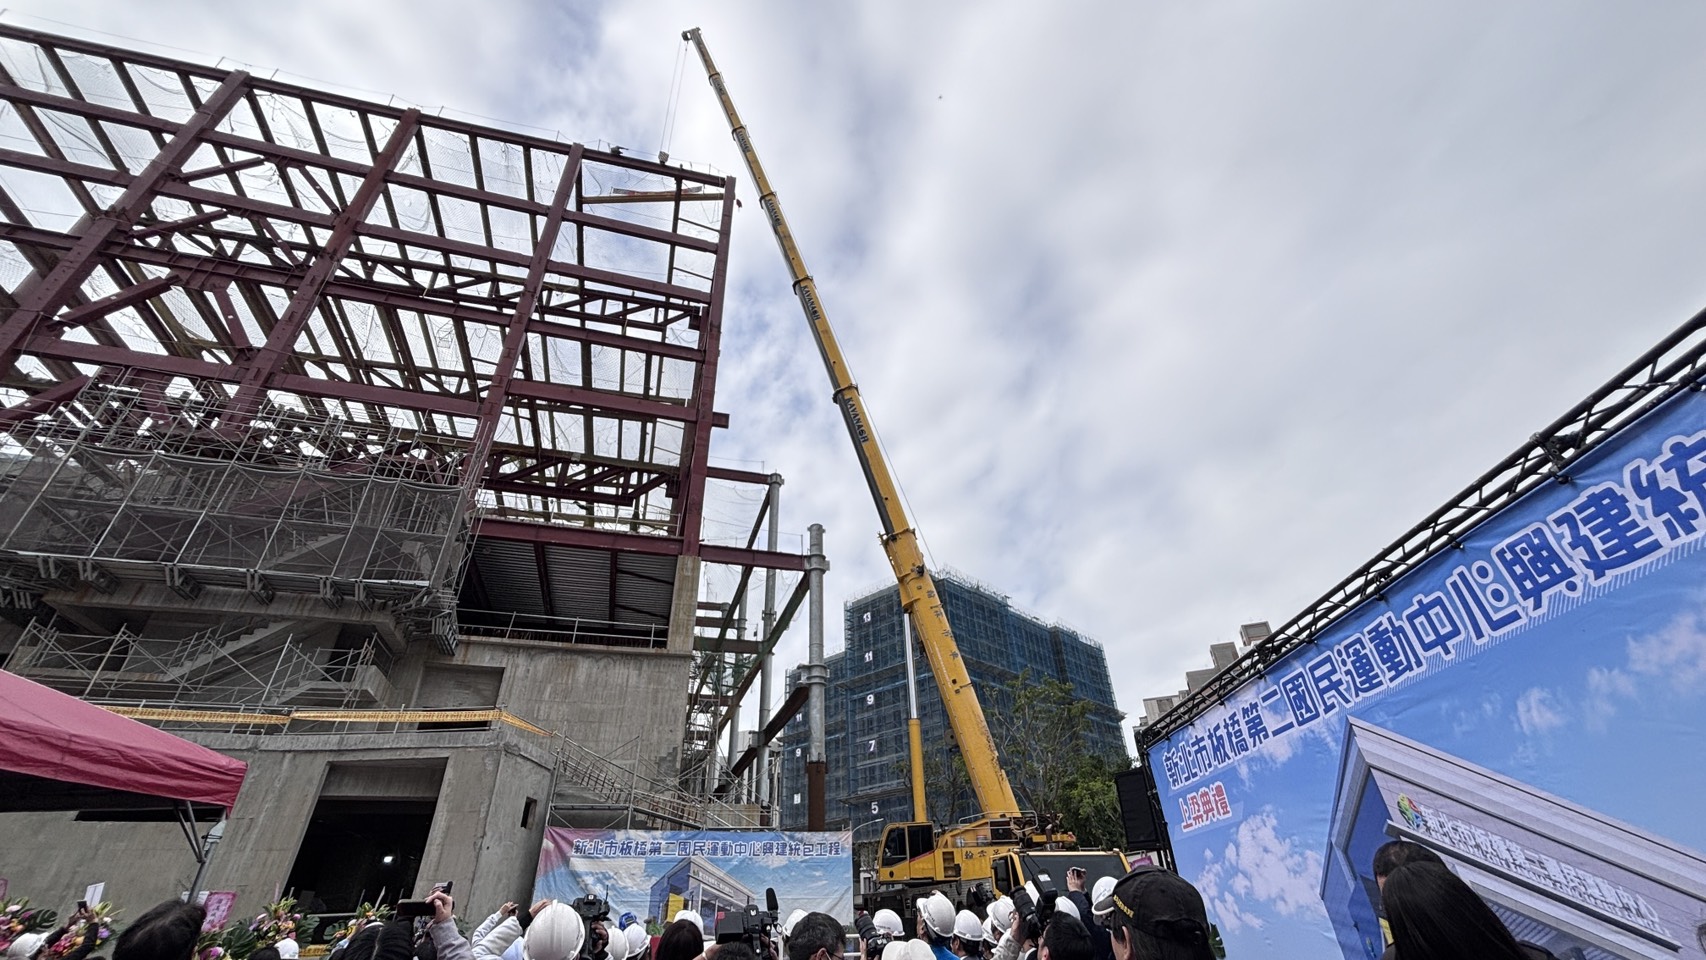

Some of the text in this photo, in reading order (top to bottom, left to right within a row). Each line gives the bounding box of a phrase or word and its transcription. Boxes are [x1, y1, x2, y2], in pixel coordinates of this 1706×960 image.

[844, 396, 870, 444] KAVANAGH
[863, 612, 871, 623] 13
[864, 651, 873, 662] 11
[866, 694, 874, 705] 9
[868, 740, 876, 751] 7
[871, 802, 879, 814] 5
[573, 839, 841, 857] 新北市板橋第二國民運動中心興建統包工程
